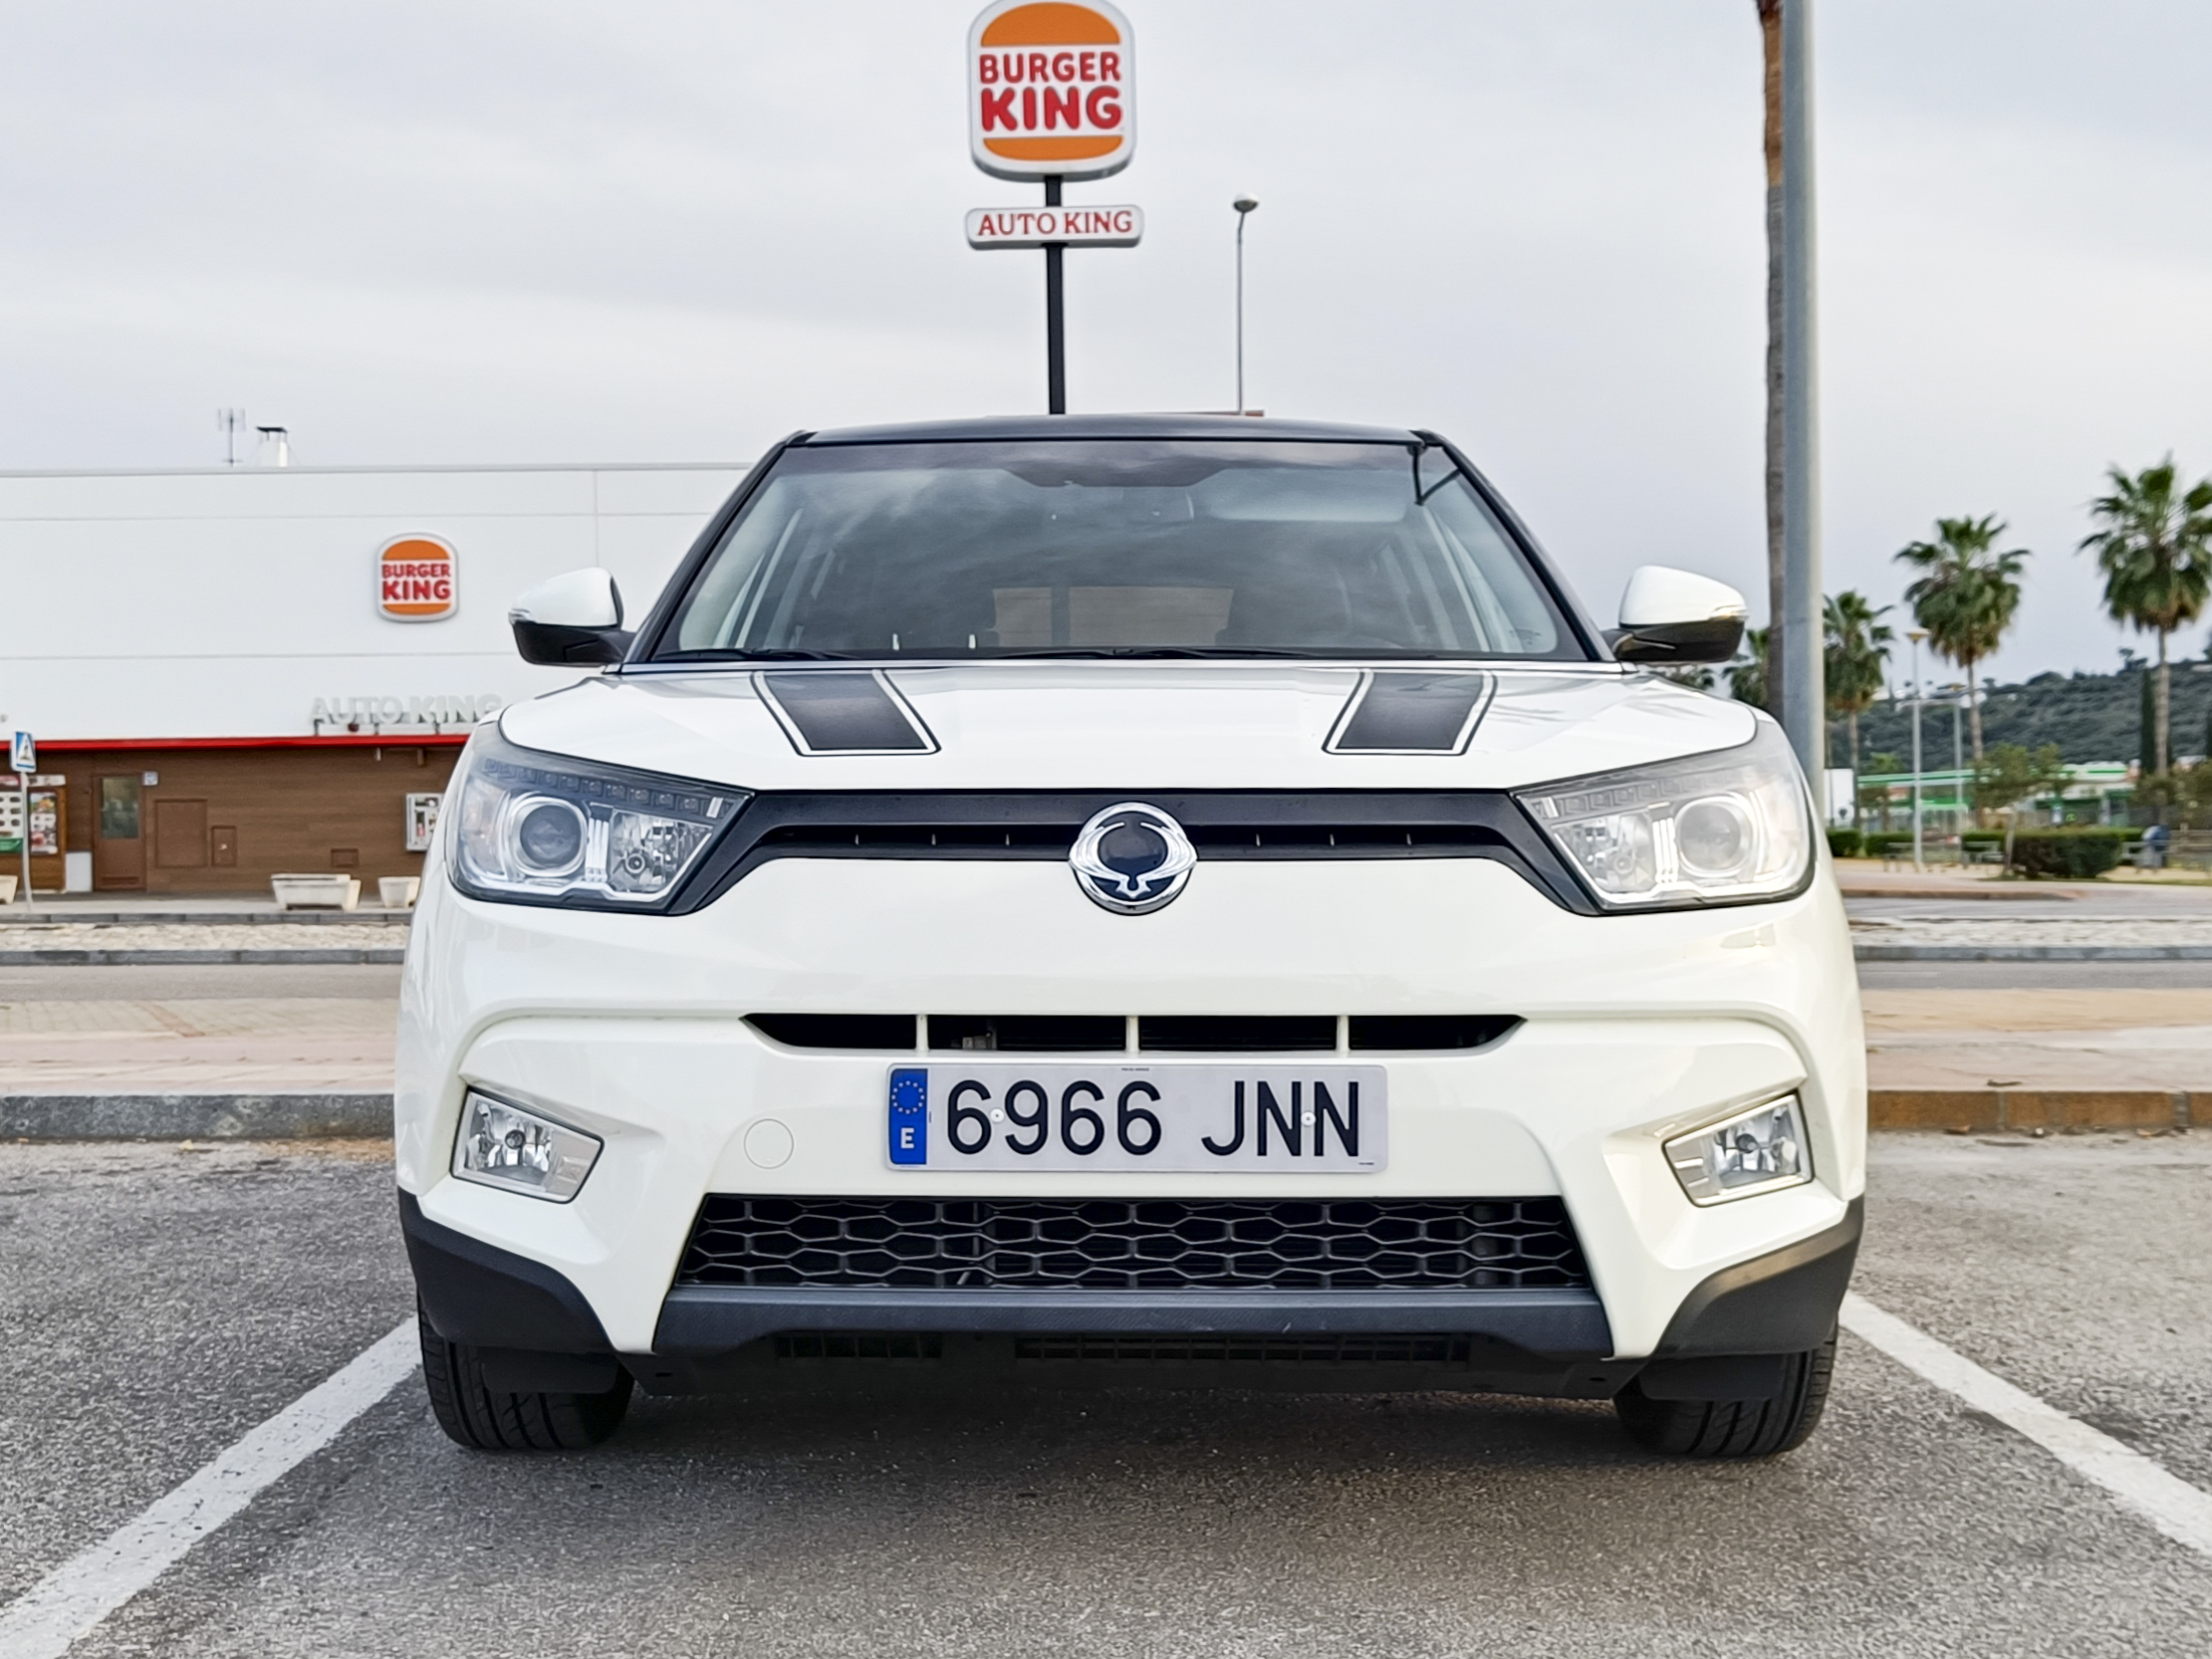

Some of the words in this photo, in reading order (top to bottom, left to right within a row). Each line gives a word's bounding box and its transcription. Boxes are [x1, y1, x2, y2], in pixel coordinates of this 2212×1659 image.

[979, 52, 1121, 84] BURGER
[981, 86, 1122, 131] KING
[977, 212, 1057, 236] AUTO
[1064, 210, 1132, 234] KING
[381, 564, 451, 579] BURGER
[382, 580, 451, 601] KING
[309, 696, 403, 725] AUTO
[947, 1079, 1163, 1155] 6966
[1201, 1080, 1359, 1157] JNN
[900, 1127, 915, 1149] E
